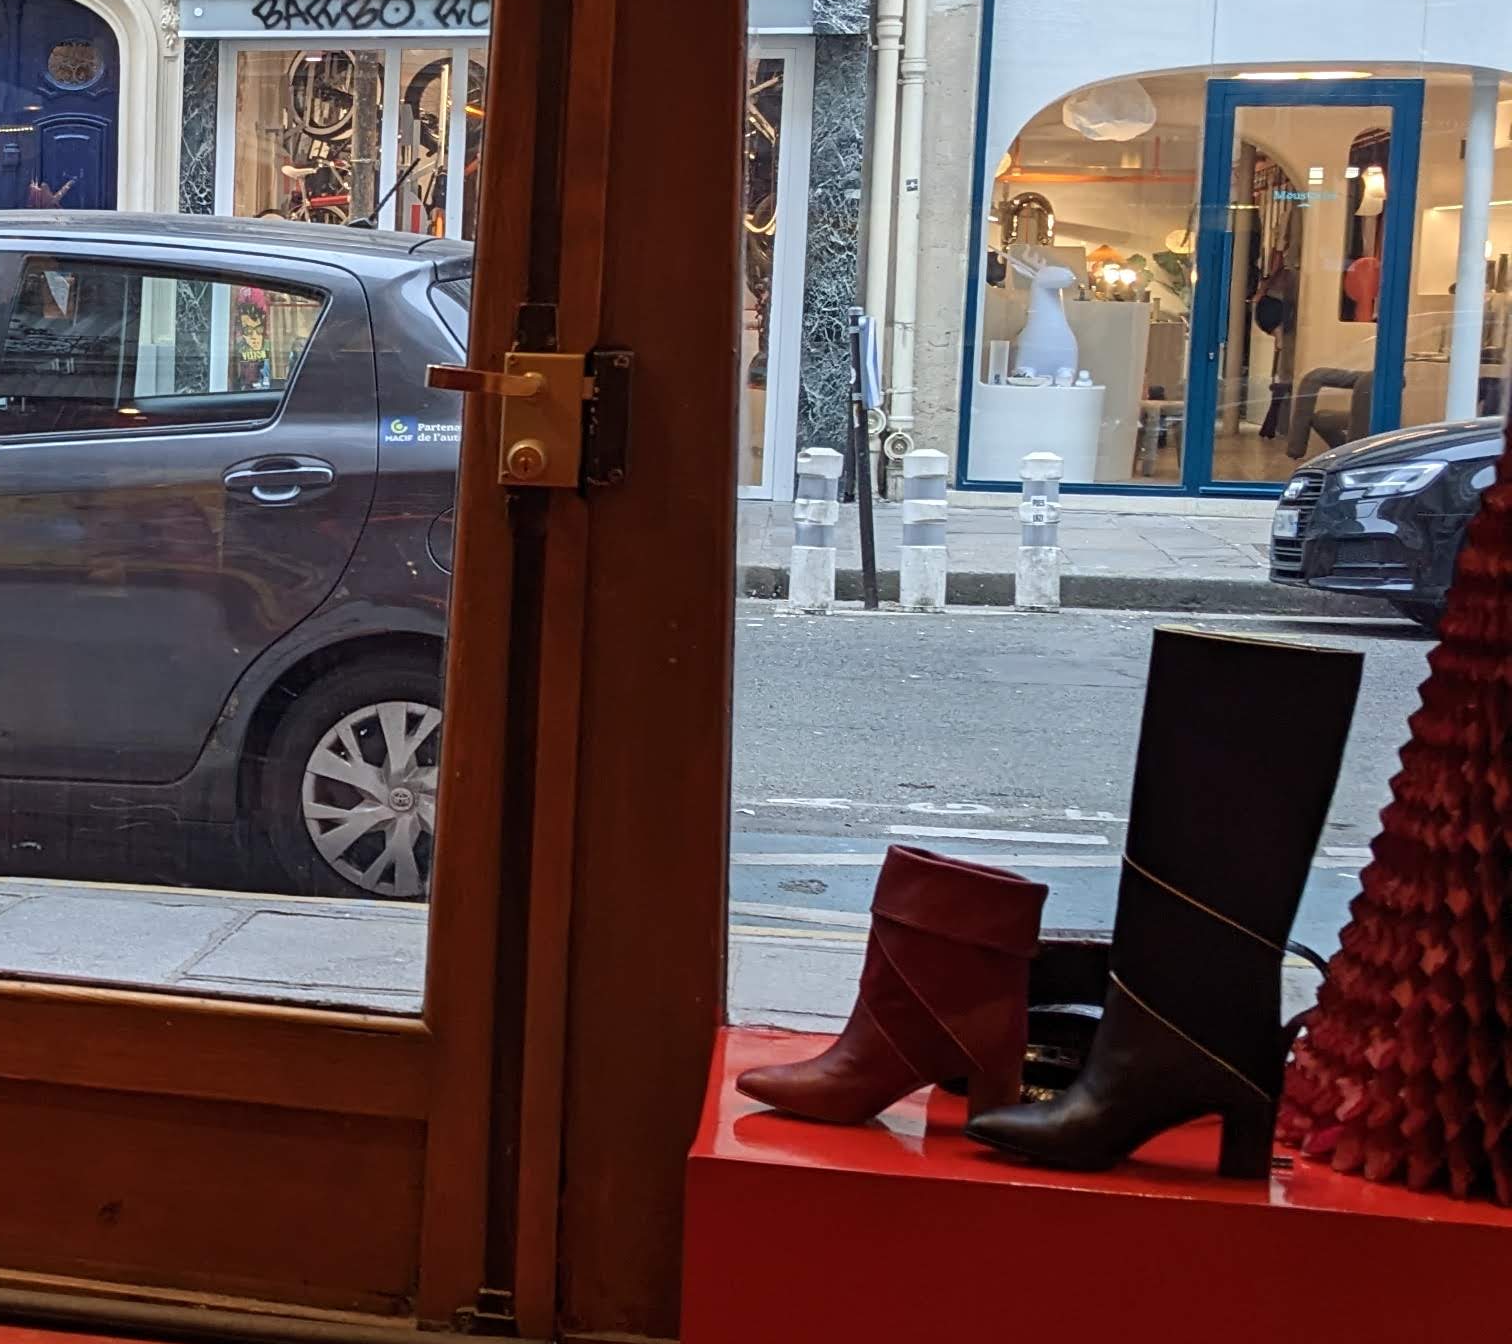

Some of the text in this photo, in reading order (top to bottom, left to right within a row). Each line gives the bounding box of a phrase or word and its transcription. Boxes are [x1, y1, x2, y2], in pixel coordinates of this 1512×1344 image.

[417, 423, 462, 432] Partena
[385, 434, 413, 442] MACIF
[417, 433, 462, 442] de l'aut
